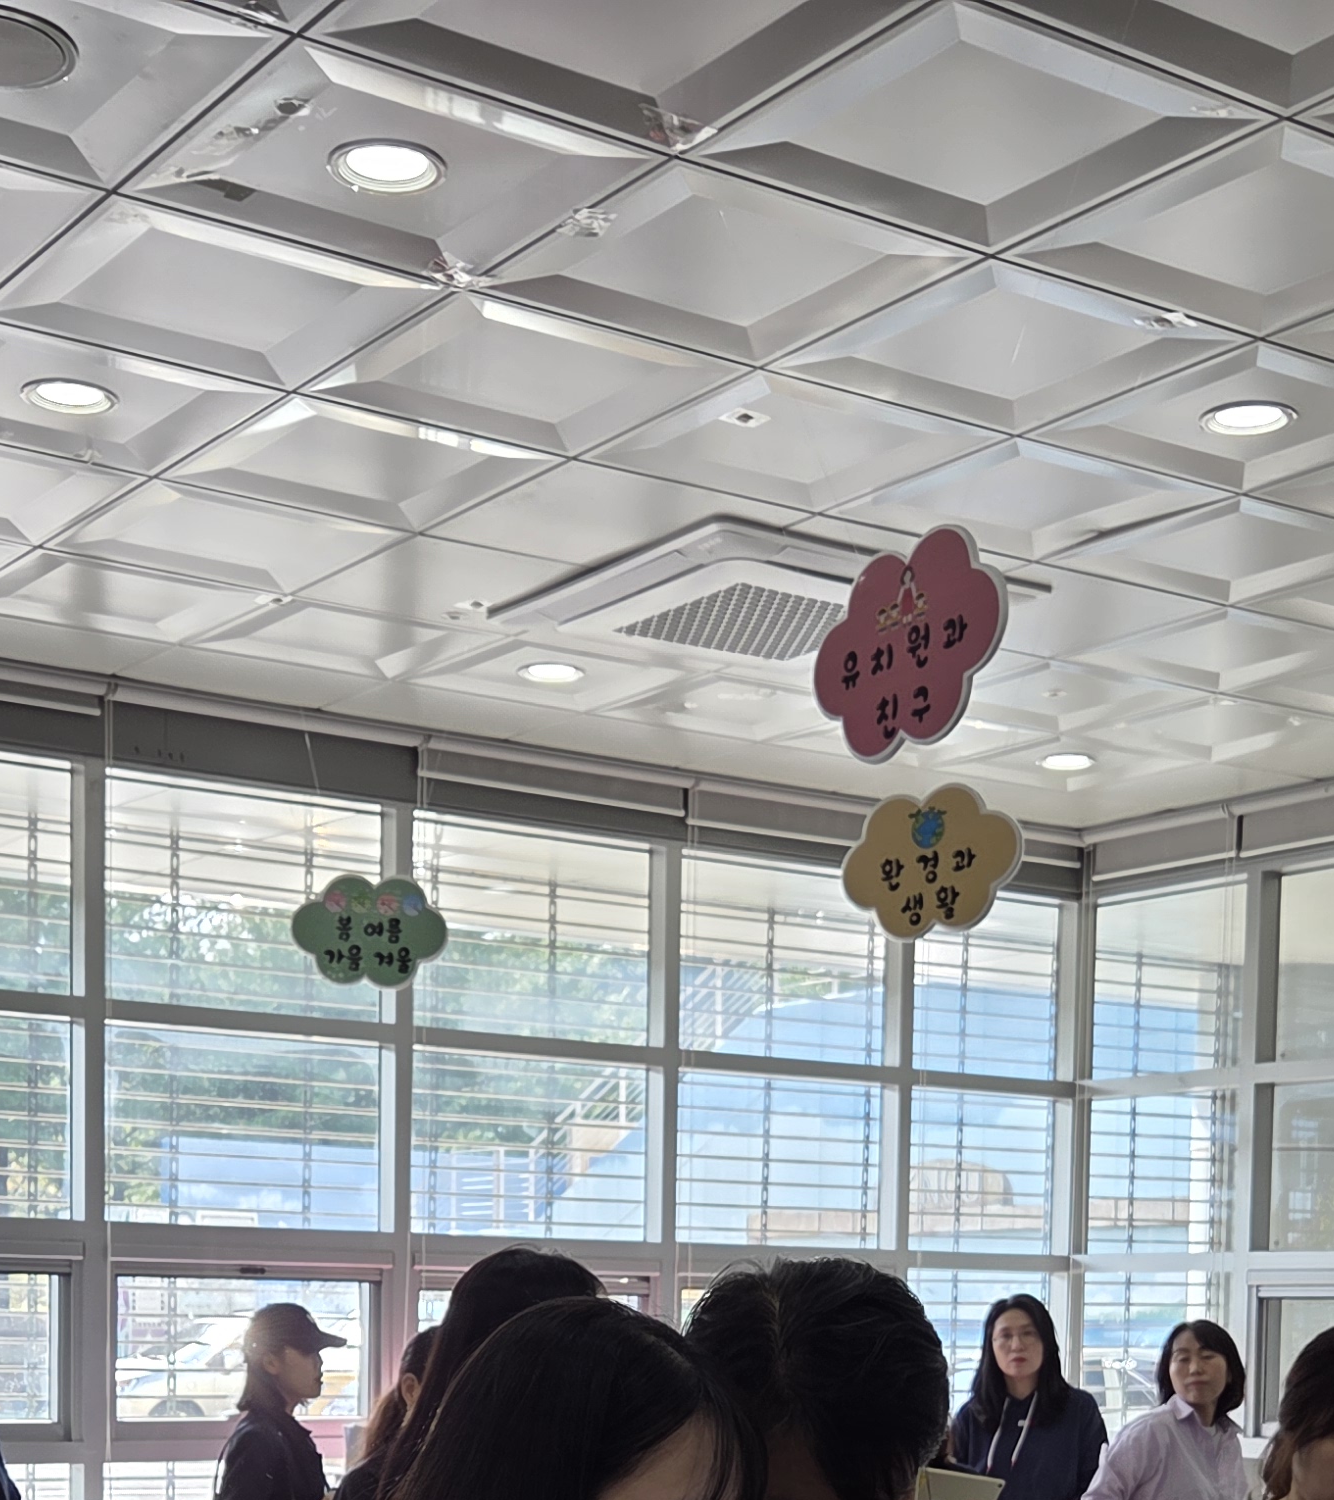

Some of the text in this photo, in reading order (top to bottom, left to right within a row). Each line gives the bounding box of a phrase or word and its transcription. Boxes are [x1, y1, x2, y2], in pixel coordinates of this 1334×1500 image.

[841, 614, 968, 690] 유치원과
[876, 683, 931, 739] 친구
[880, 847, 976, 892] 환경과
[901, 885, 960, 926] 생활
[336, 915, 403, 944] 봄 여름
[324, 944, 412, 974] 가을 겨울
